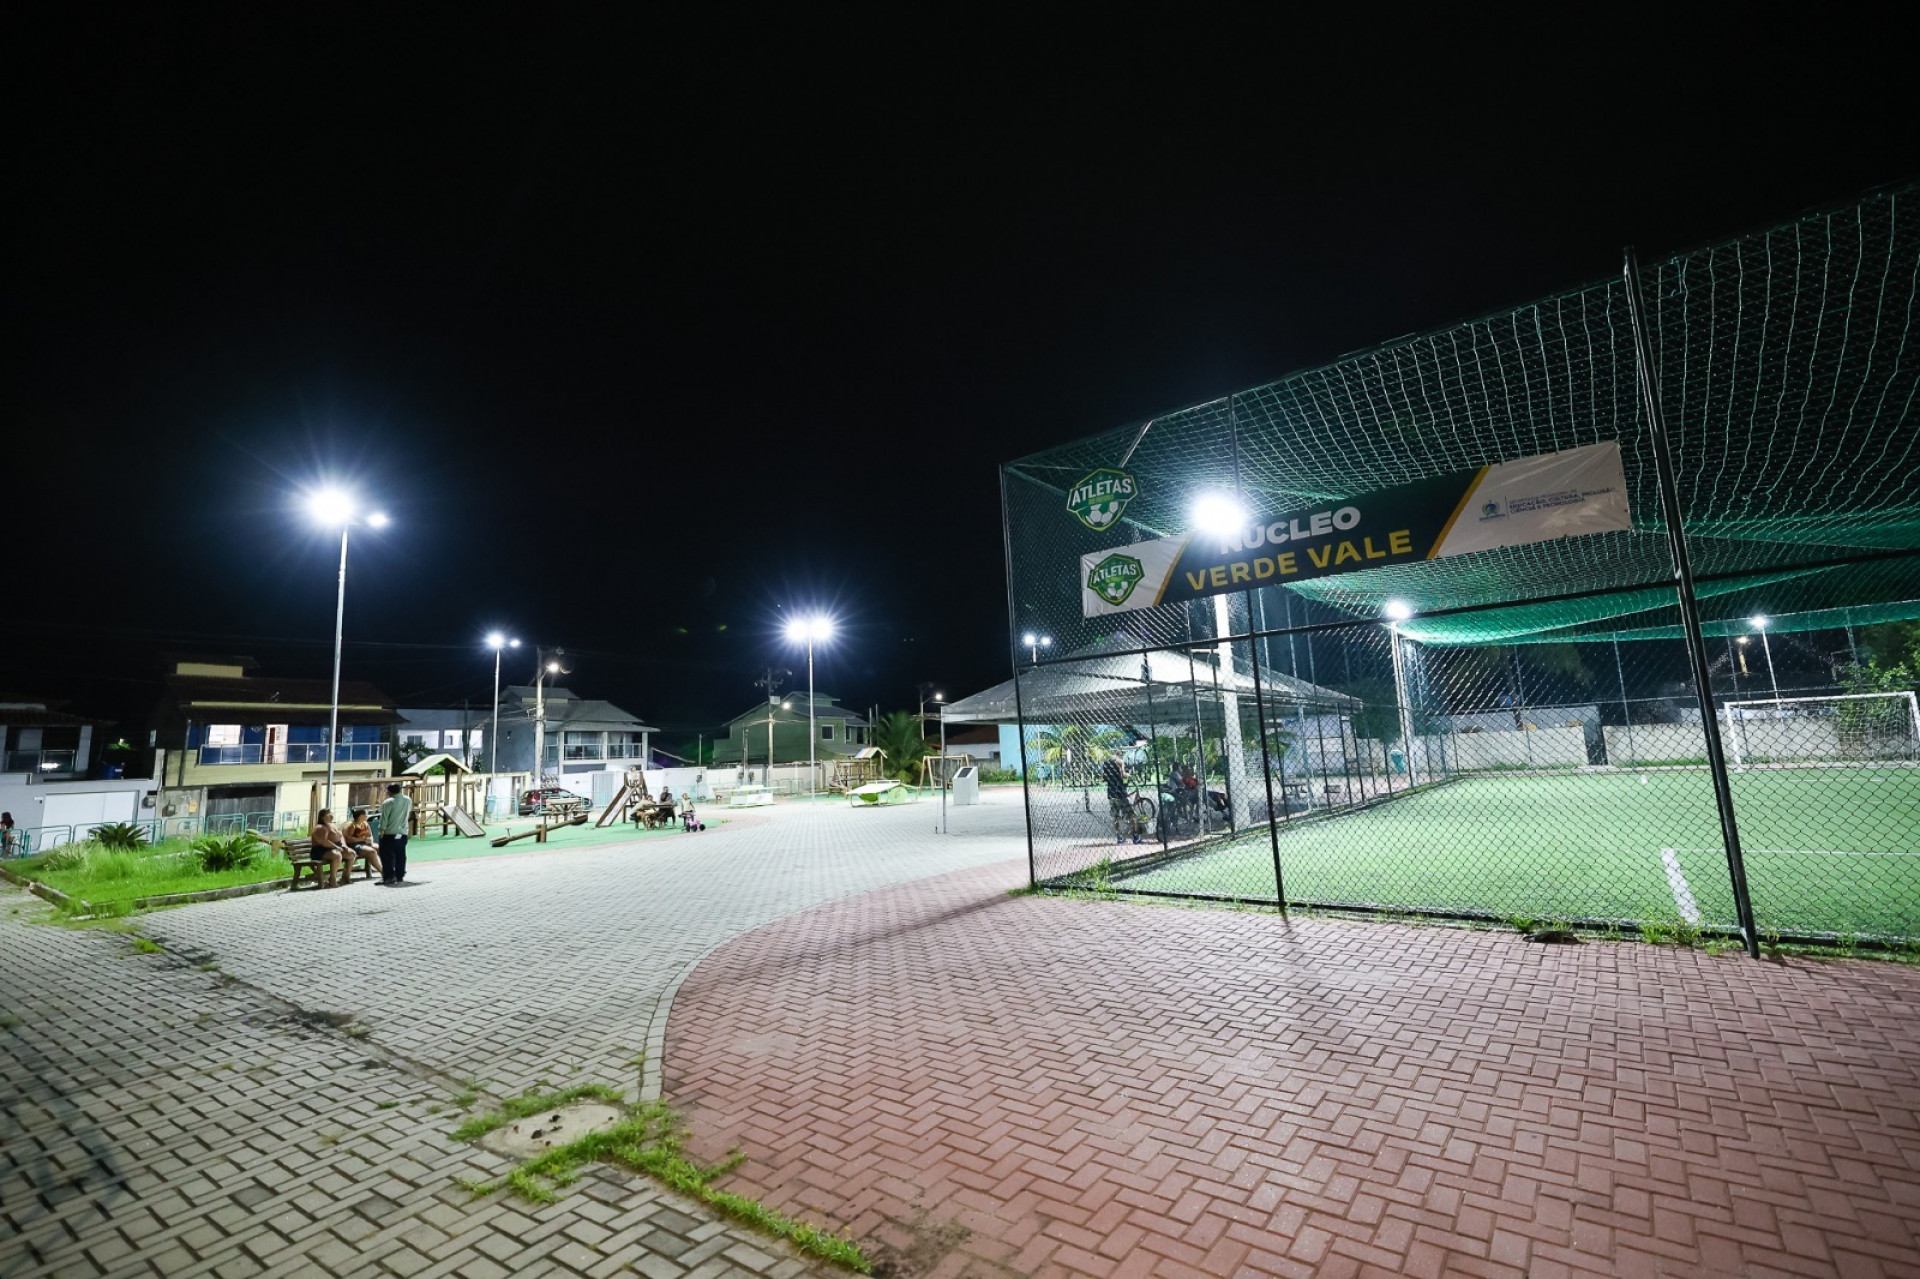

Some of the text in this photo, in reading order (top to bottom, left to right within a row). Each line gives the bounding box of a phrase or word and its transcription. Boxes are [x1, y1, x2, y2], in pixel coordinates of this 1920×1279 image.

[1071, 477, 1132, 507] ATLETAS
[1093, 563, 1137, 584] ATLETAS
[1186, 529, 1412, 591] VERDE VALE
